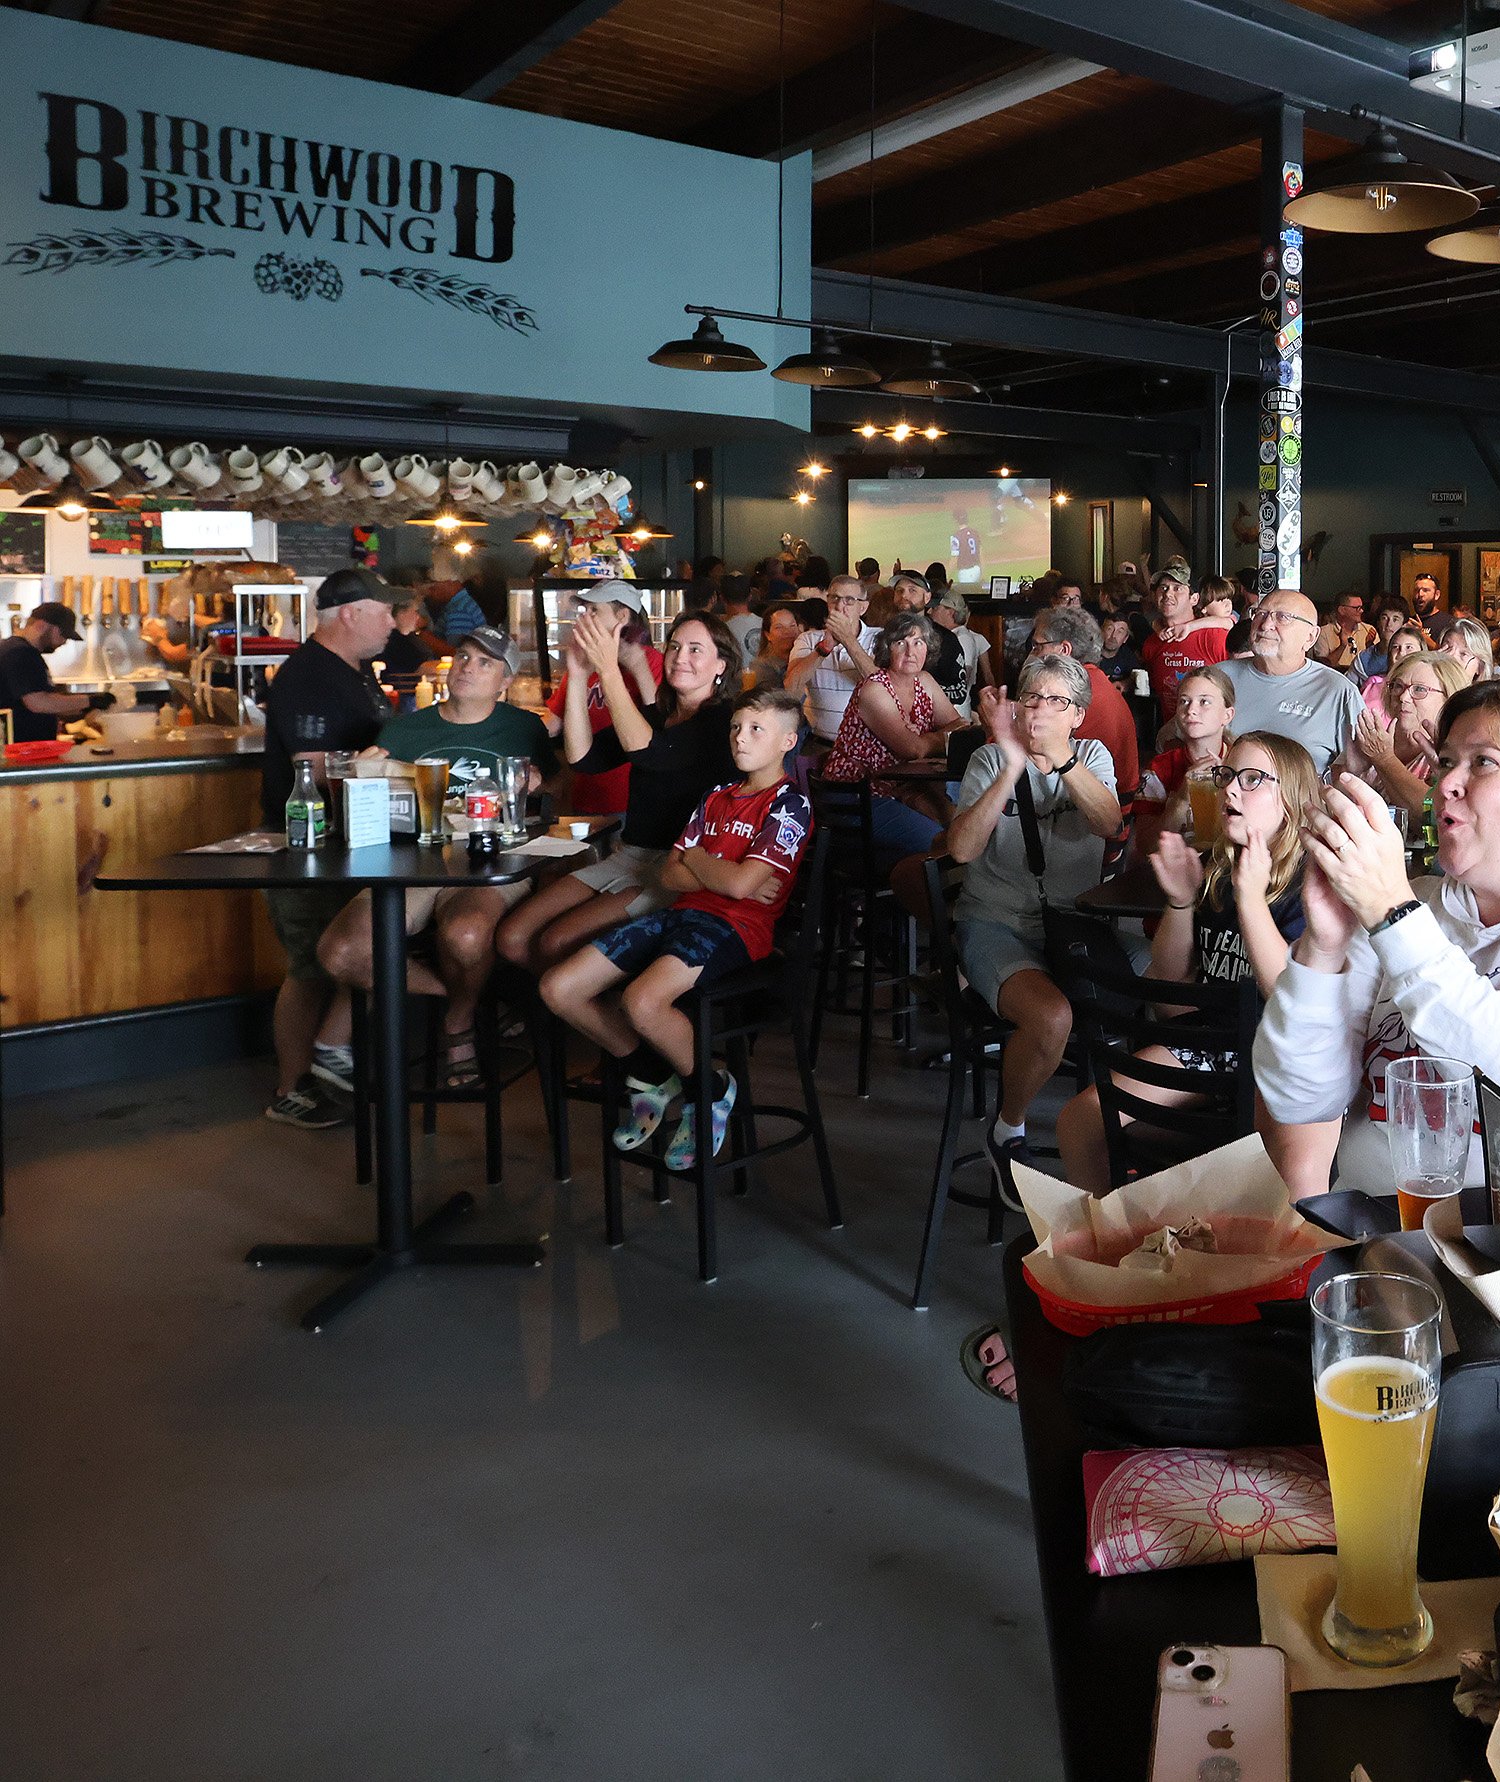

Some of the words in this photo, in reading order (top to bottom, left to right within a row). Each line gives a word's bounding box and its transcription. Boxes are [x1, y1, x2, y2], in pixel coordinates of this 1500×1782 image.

[37, 91, 516, 264] BIRCHWOOD
[140, 176, 438, 254] BREWING
[1432, 492, 1462, 501] RESTROOM
[1164, 657, 1182, 667] Grass
[1183, 656, 1205, 668] Drags
